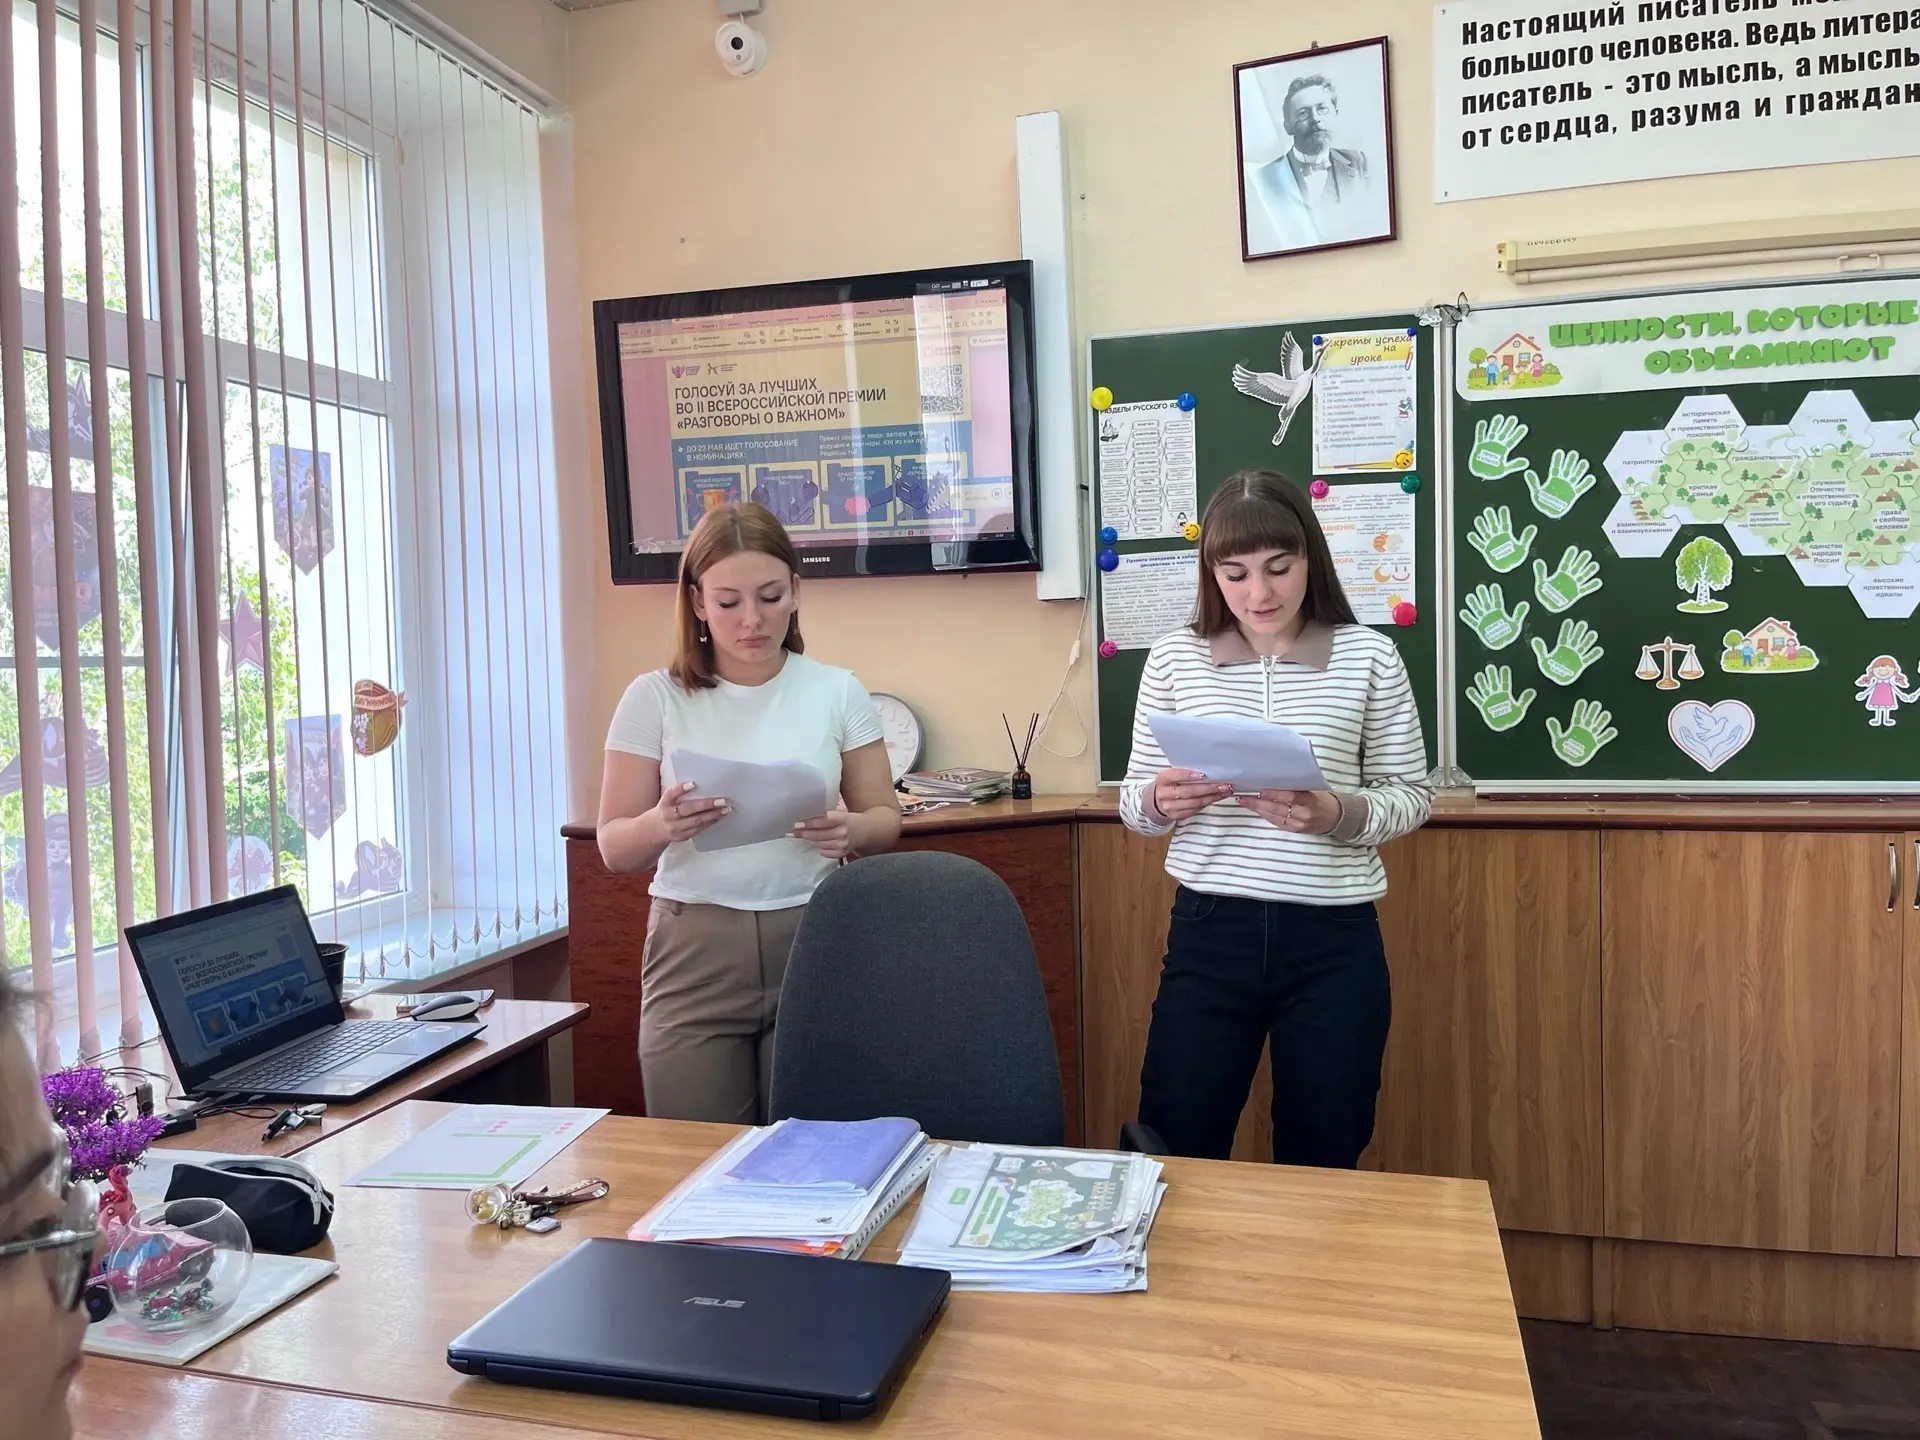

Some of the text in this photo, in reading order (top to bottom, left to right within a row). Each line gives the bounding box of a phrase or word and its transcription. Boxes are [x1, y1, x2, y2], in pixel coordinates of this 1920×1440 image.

[1462, 2, 1624, 45] Настоящий
[1462, 45, 1594, 80] большого
[1601, 28, 1739, 62] человека.
[1746, 21, 1816, 46] Ведь
[1462, 81, 1592, 115] писатель
[1626, 71, 1671, 94] это
[1678, 61, 1783, 88] мысль,
[1796, 57, 1811, 77] а
[1818, 47, 1920, 75] мысль
[1462, 128, 1492, 150] от
[1500, 113, 1617, 144] сердца,
[1631, 99, 1740, 132] разума
[1755, 97, 1771, 117] и
[1549, 300, 1918, 347] ЦЕННОСТИ, КОТОРЫЕ
[1375, 334, 1412, 346] успеха
[1351, 355, 1382, 366] уроке
[1644, 336, 1895, 374] ОБЪЕДИНЯЮТ
[675, 378, 817, 399] ГОЛОСУЙ ЗА ЛУЧШИХ
[676, 403, 694, 414] ВО
[708, 390, 825, 413] ВСЕРОССИЙСКОЙ
[829, 388, 886, 404] ПРЕМИИ
[1133, 403, 1168, 411] РУССКОГО
[677, 408, 845, 430] «РАЗГОВОРЫ О ВАЖНОМ»
[1677, 424, 1739, 432] преемственность
[686, 445, 696, 453] ДО
[724, 443, 743, 452] ИДЕТ
[745, 439, 799, 449] ГОЛОСОВАНИЕ
[693, 452, 746, 461] НОМИНАЦИЯХ:
[683, 1296, 746, 1308] ASUS
